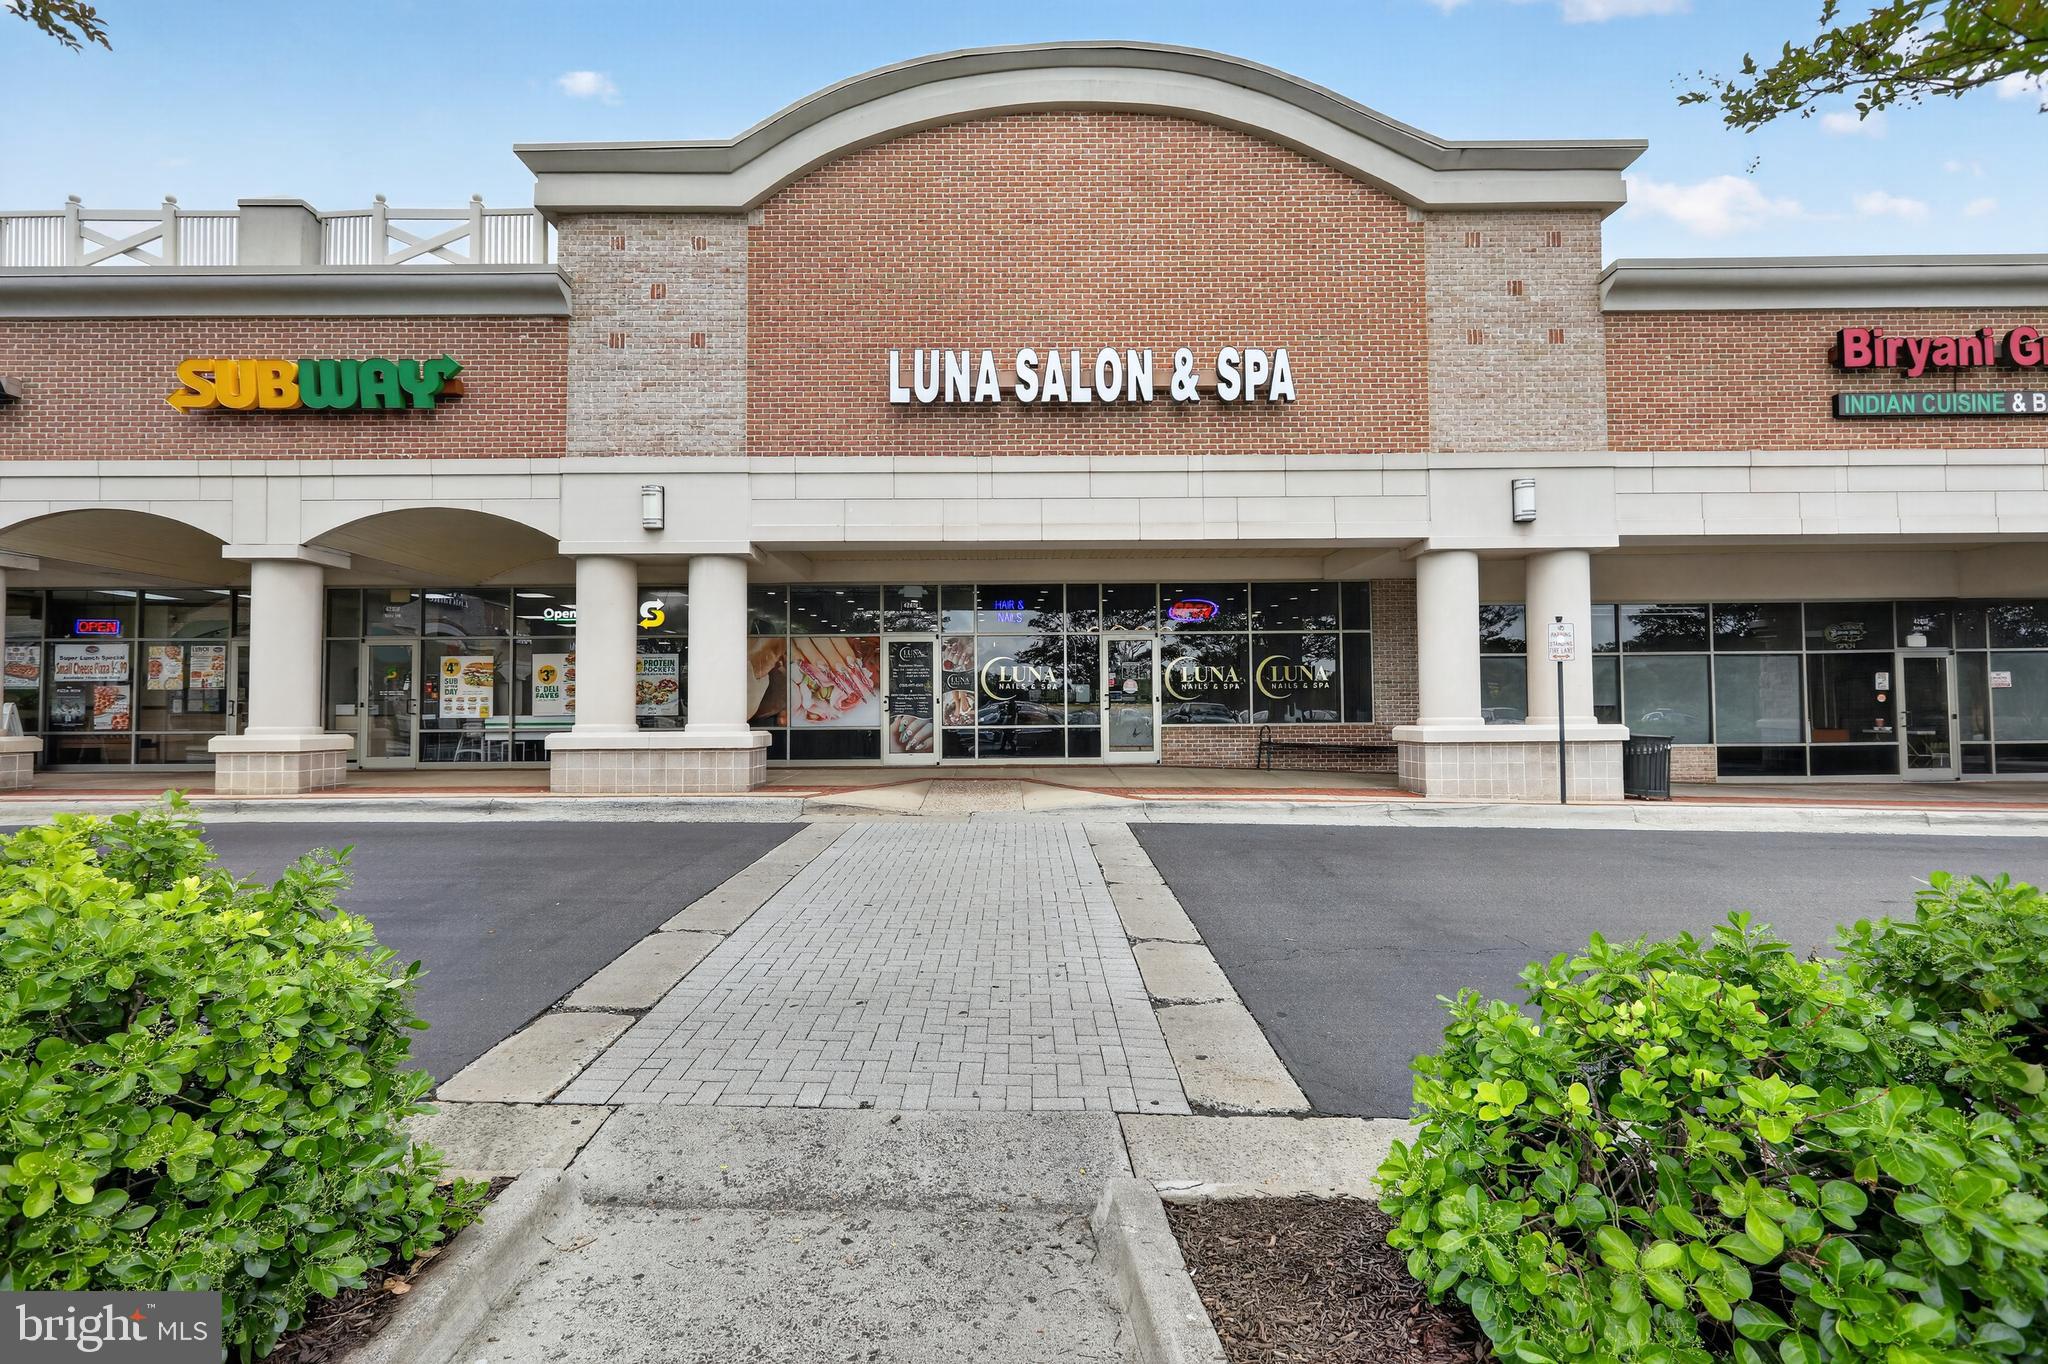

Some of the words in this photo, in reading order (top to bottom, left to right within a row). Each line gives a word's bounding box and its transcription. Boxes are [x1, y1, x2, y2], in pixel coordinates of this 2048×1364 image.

[1843, 327, 1995, 378] Biryani
[2009, 326, 2048, 366] G
[889, 348, 1002, 404] LUNA
[1015, 346, 1155, 404] SALON
[1170, 346, 1200, 403] &
[1216, 346, 1297, 403] SPA
[165, 353, 465, 415] SUBWAY
[1845, 395, 1915, 414] INDIAN
[1922, 394, 2006, 414] CUISINE
[2012, 392, 2027, 412] &
[2032, 392, 2048, 412] B
[995, 599, 1014, 610] HAIR
[543, 607, 577, 621] Open
[997, 612, 1023, 623] NAILS
[79, 621, 117, 633] OPEN
[56, 662, 72, 674] Small
[73, 662, 93, 674] Cheese
[94, 662, 110, 674] Pizza
[999, 665, 1057, 683] LUNA
[1181, 665, 1240, 683] LUNA
[1270, 665, 1329, 682] LUNA
[444, 688, 459, 696] DAY
[1271, 682, 1298, 690] NAILS
